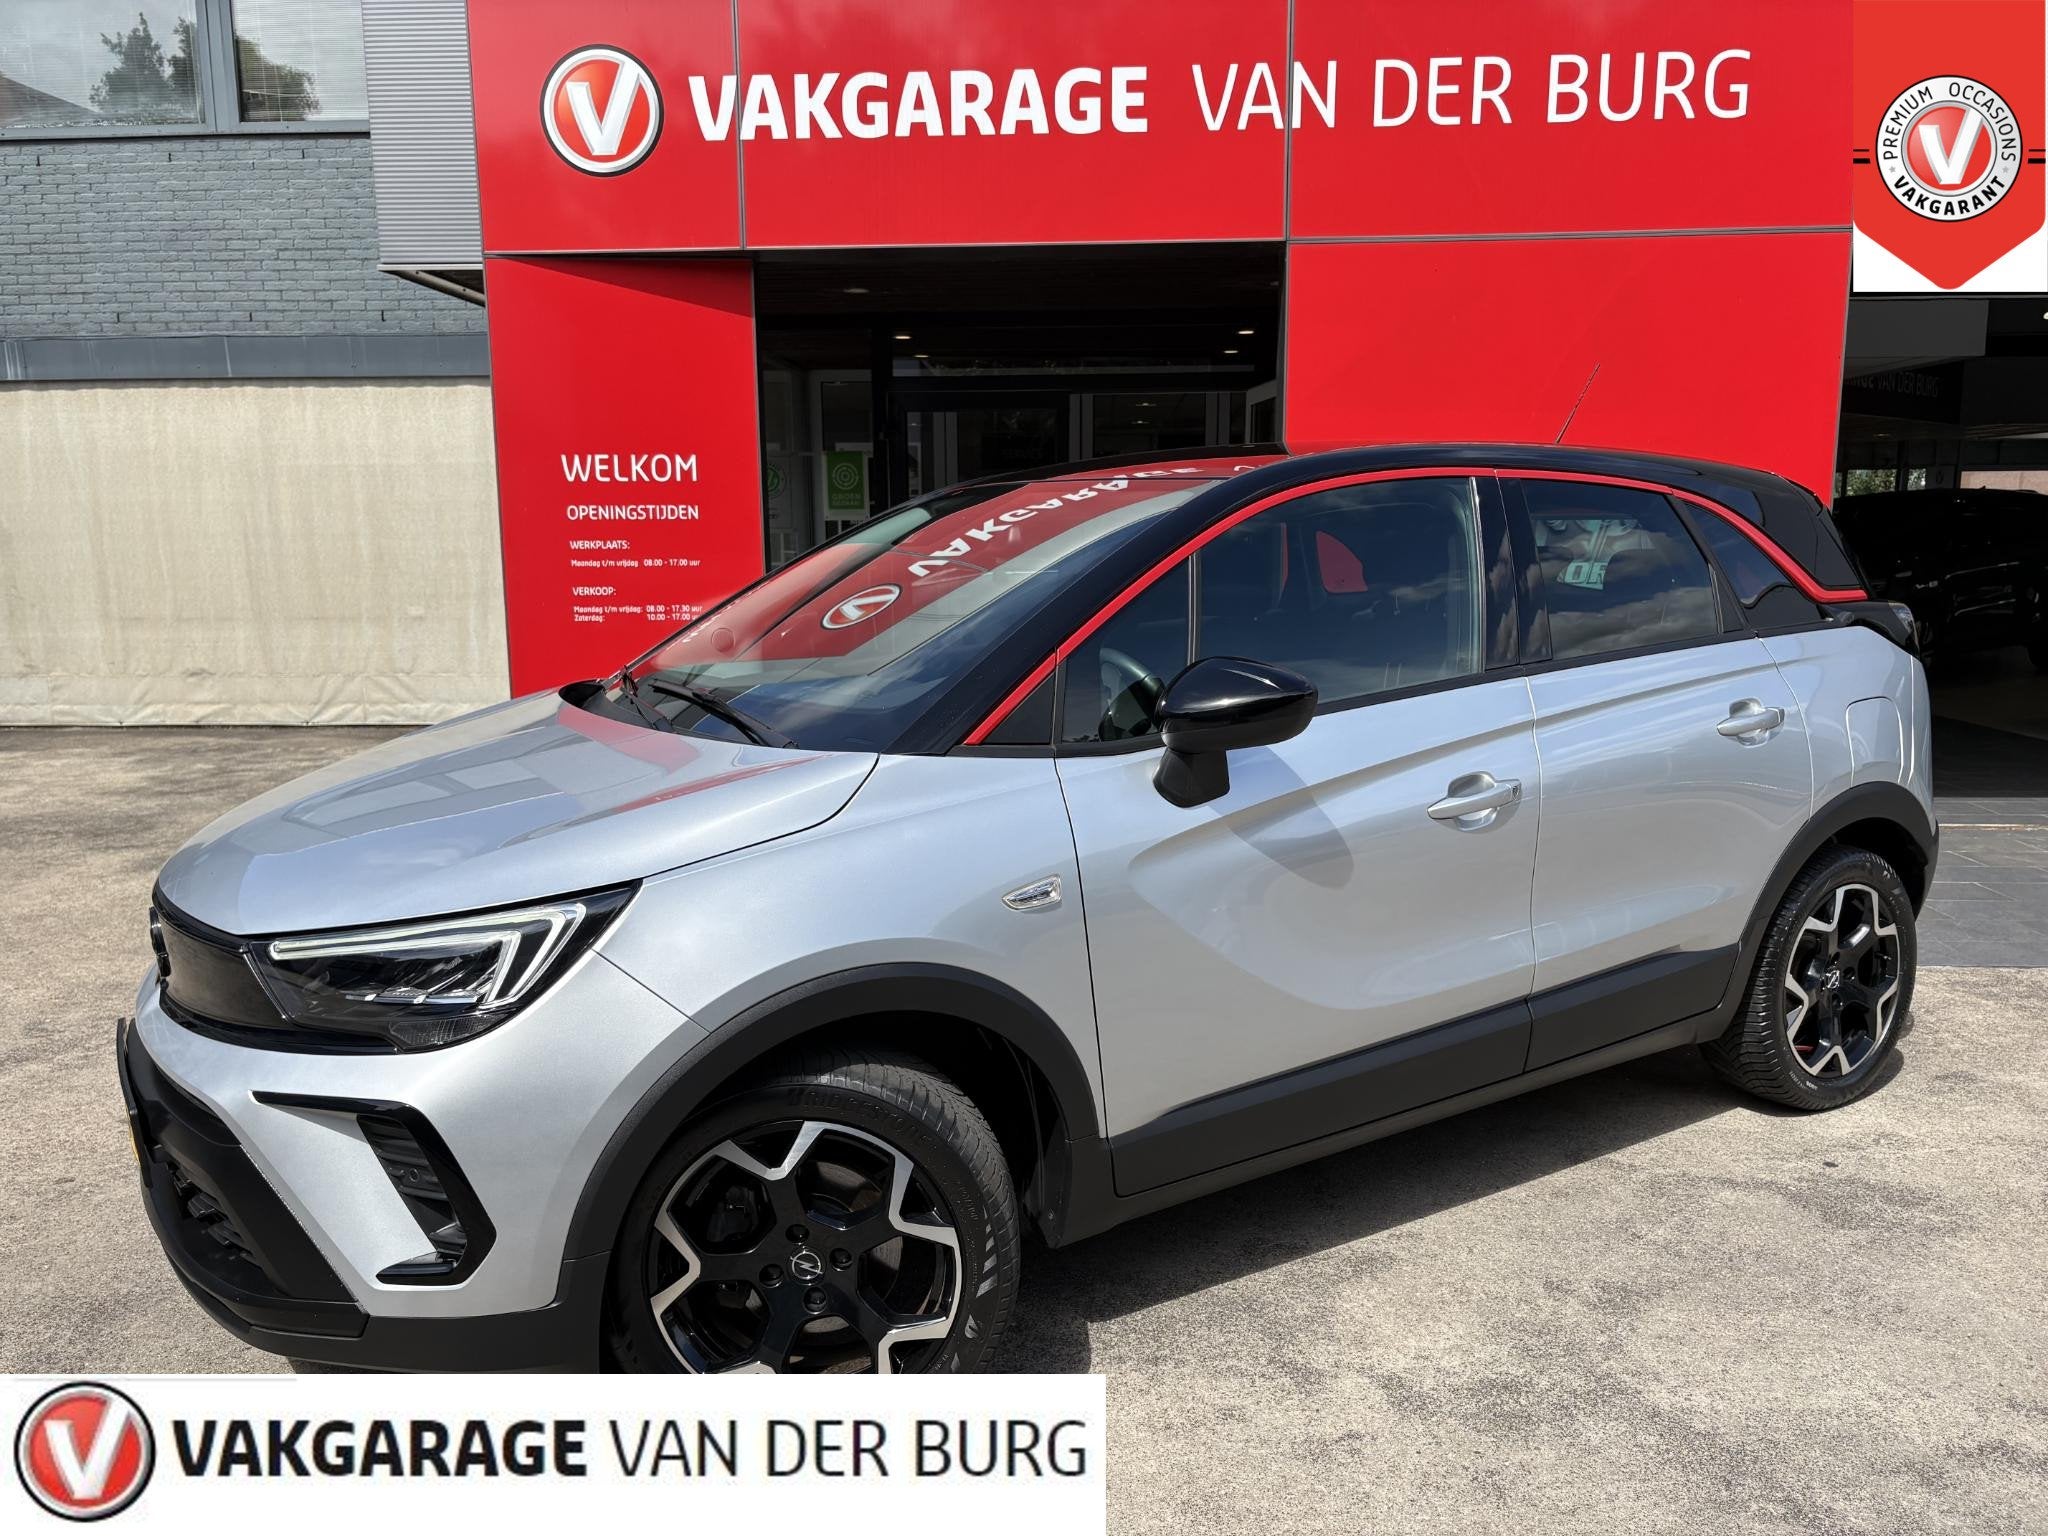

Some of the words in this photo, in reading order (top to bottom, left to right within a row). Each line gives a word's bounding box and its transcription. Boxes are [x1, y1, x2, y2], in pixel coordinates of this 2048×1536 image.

[687, 66, 1148, 141] VAKGARAGE
[1191, 61, 1337, 131] VAN
[1373, 56, 1513, 128] DER
[1546, 49, 1751, 124] BURG
[560, 453, 698, 482] WELKOM
[566, 504, 699, 520] OPENINGSTIJDEN
[569, 540, 631, 550] WERKPLAATS:
[571, 558, 600, 568] Maandag
[602, 559, 615, 567] t/m
[616, 558, 639, 568] vrijdag
[643, 558, 663, 567] 08.00
[669, 558, 688, 567] 17.00
[572, 586, 617, 596] VERKOOP:
[573, 605, 603, 615] Maandag
[605, 605, 617, 613] t/m
[691, 605, 703, 613] uur
[646, 613, 666, 622] 10.00
[671, 613, 691, 621] 17.00
